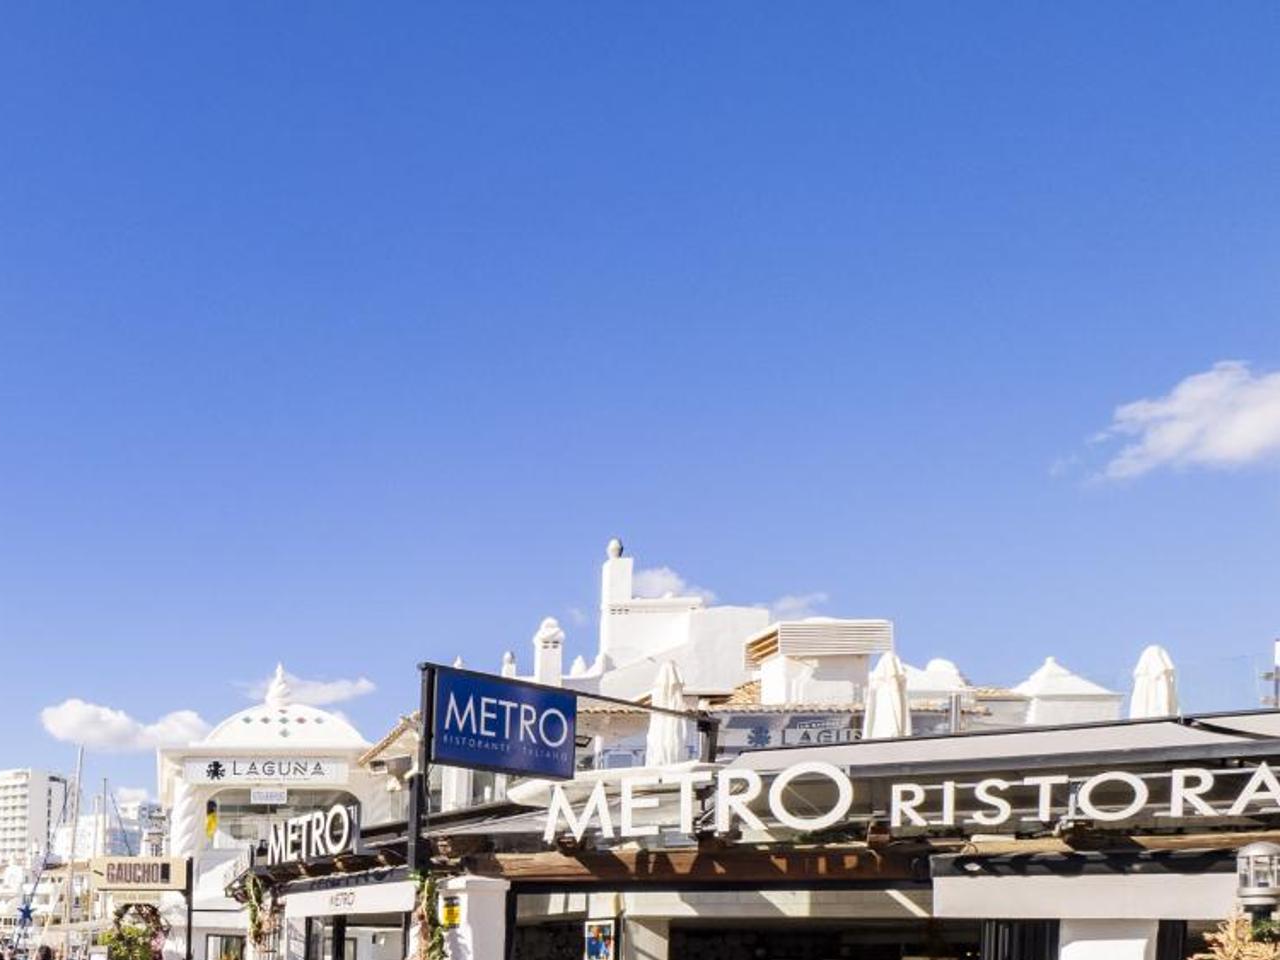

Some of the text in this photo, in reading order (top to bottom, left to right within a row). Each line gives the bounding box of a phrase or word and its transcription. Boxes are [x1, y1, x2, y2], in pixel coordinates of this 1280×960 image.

[444, 691, 568, 747] METRO
[233, 760, 325, 776] LAGUNA
[543, 761, 1280, 844] METRO RISTORA
[267, 804, 349, 865] METRO
[107, 863, 160, 884] GAUCHO
